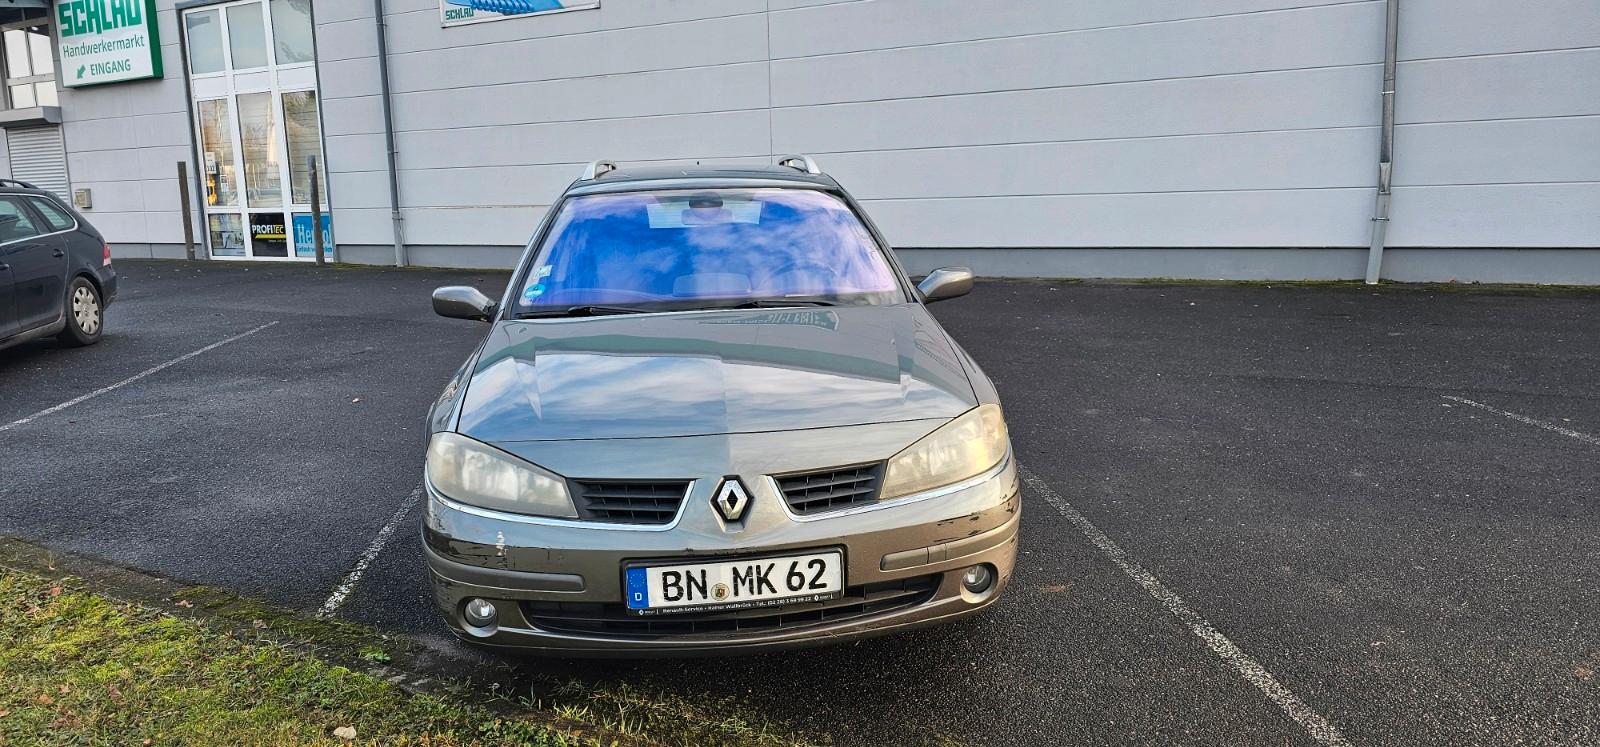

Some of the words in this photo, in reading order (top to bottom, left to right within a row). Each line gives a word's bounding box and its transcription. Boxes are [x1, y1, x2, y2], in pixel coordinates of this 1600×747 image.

[58, 0, 142, 37] SCHLAU
[445, 9, 474, 20] SCHLAU
[62, 34, 145, 58] Handwerkermarkt
[90, 59, 131, 76] EINGANG
[251, 224, 284, 234] PROFITEC
[661, 569, 708, 601] BN
[732, 563, 778, 597] MK
[786, 558, 828, 591] 62
[634, 592, 642, 601] D
